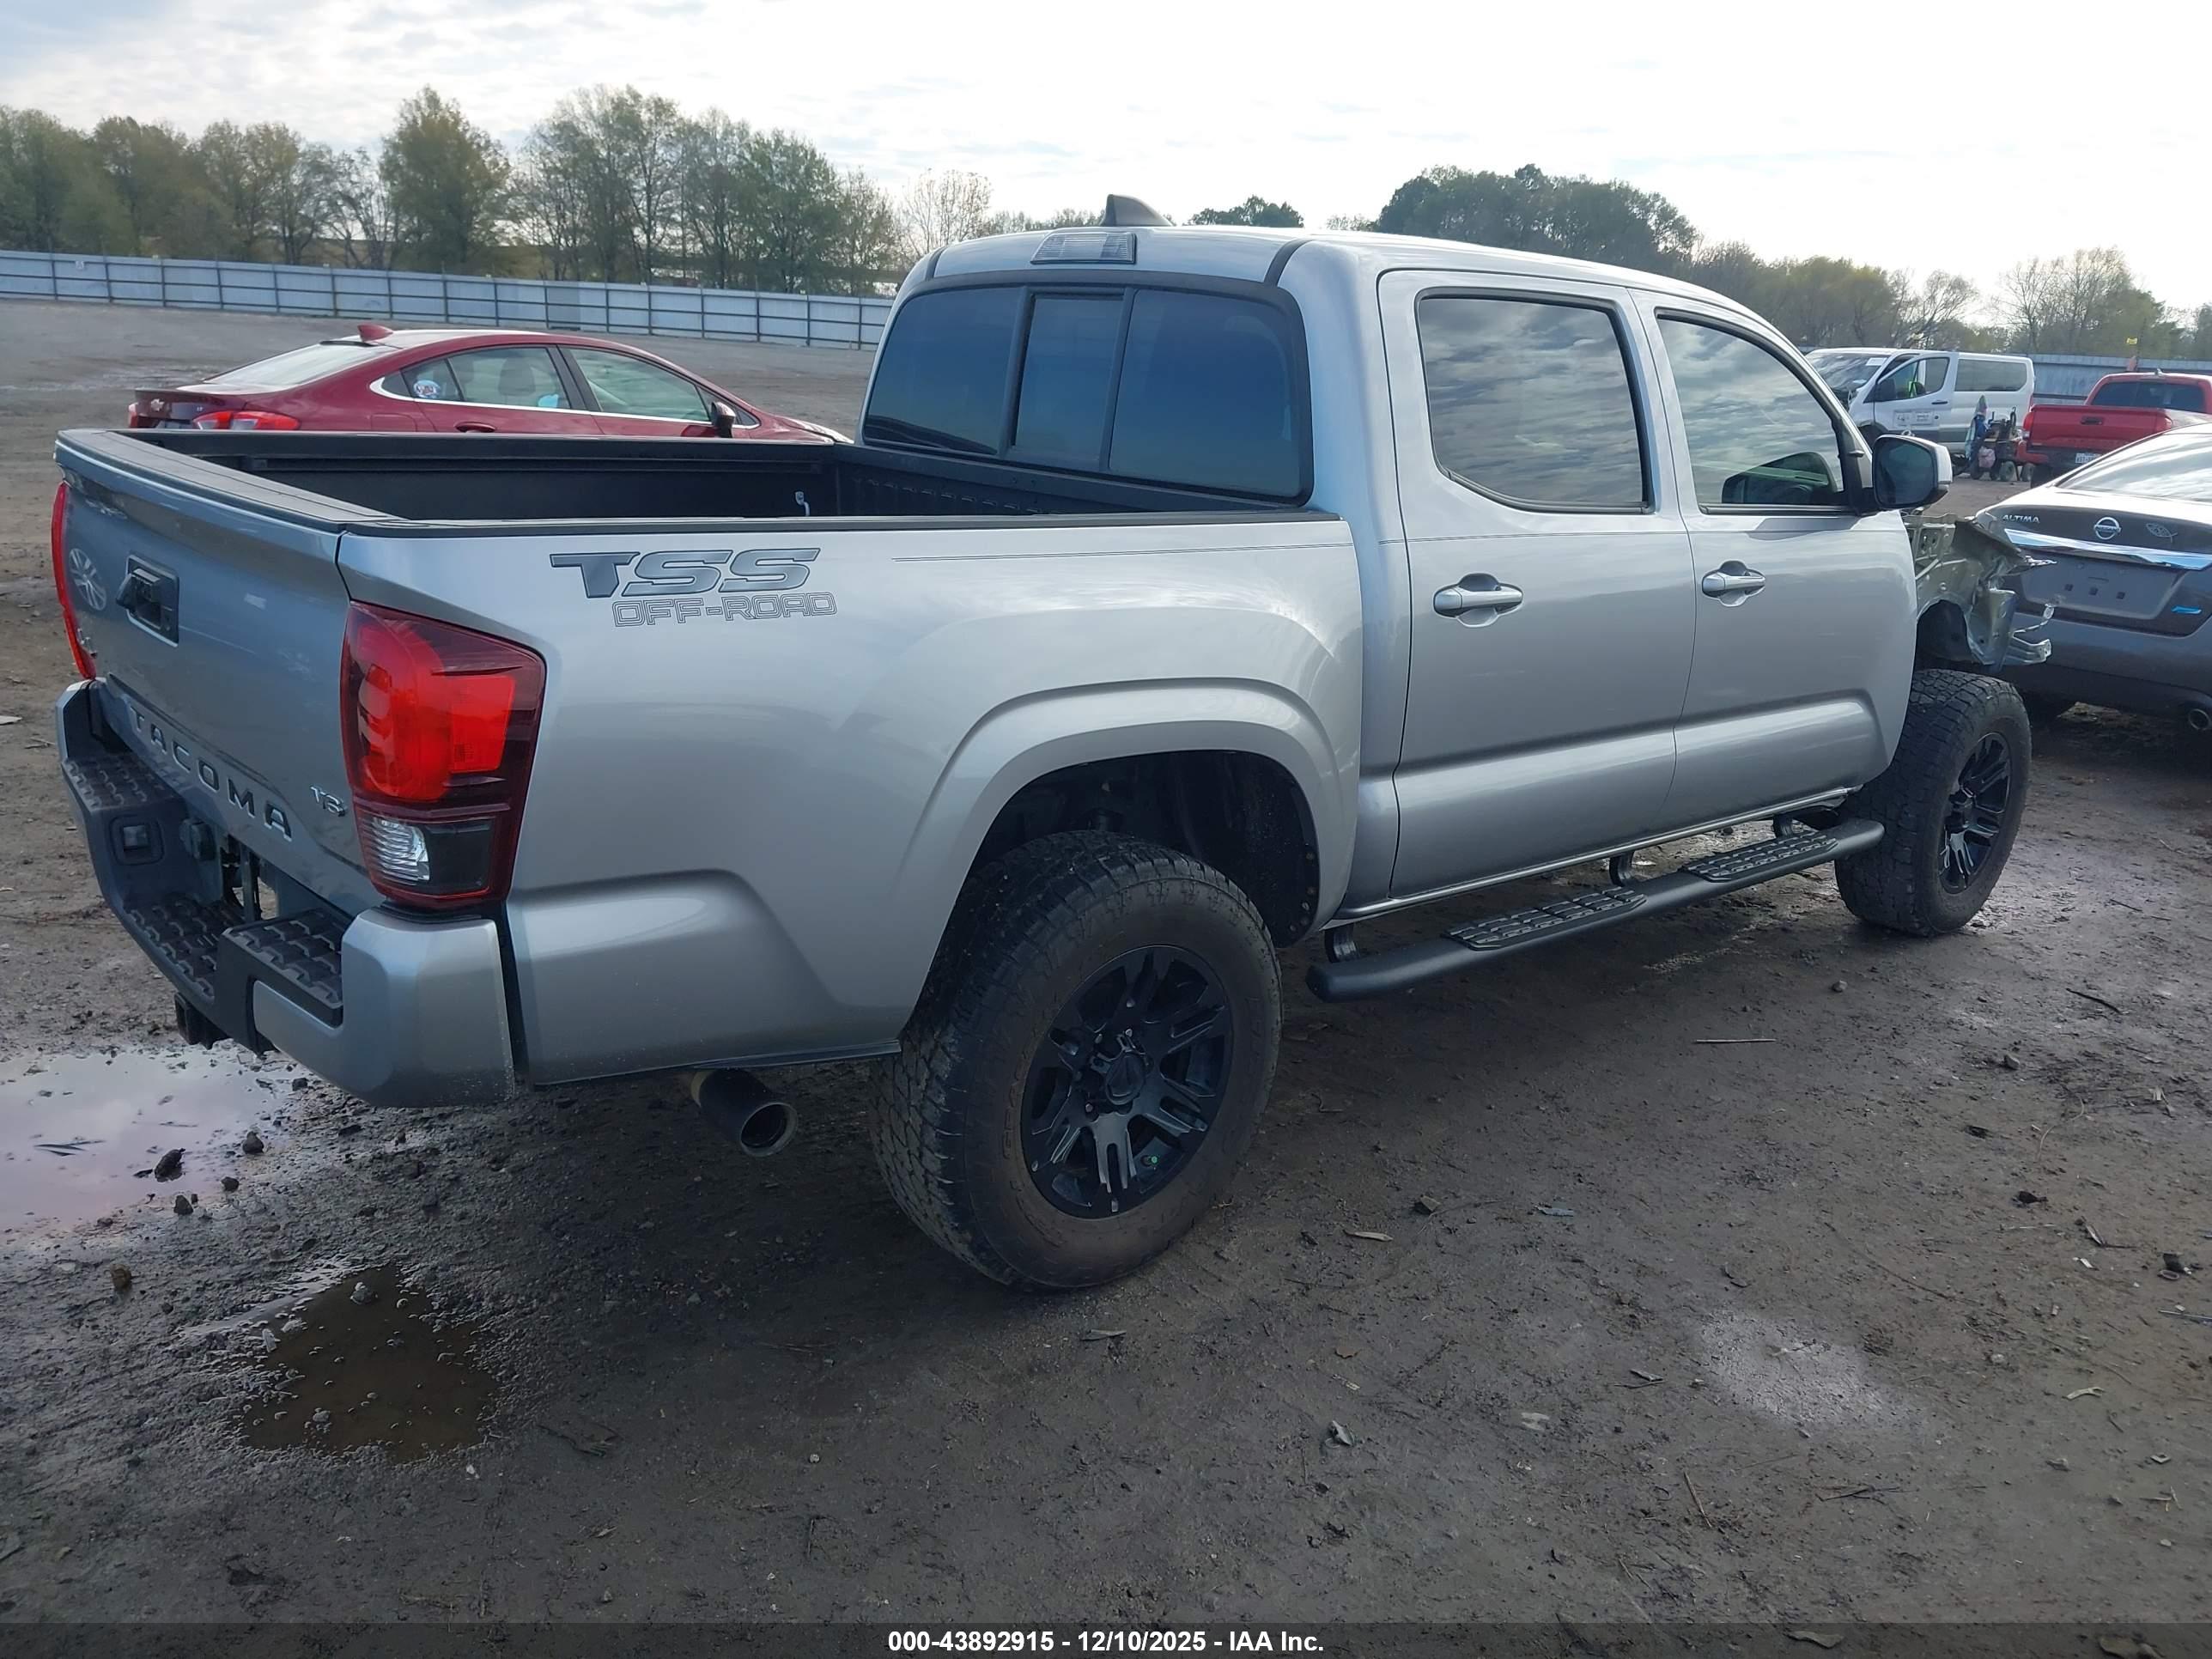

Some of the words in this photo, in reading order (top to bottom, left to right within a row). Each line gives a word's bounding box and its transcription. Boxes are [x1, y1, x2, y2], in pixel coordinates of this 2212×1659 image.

[2002, 514, 2040, 524] ALTIMA
[550, 548, 821, 599] TSS
[612, 592, 838, 628] OFF-ROAD
[130, 706, 293, 842] TACOMA
